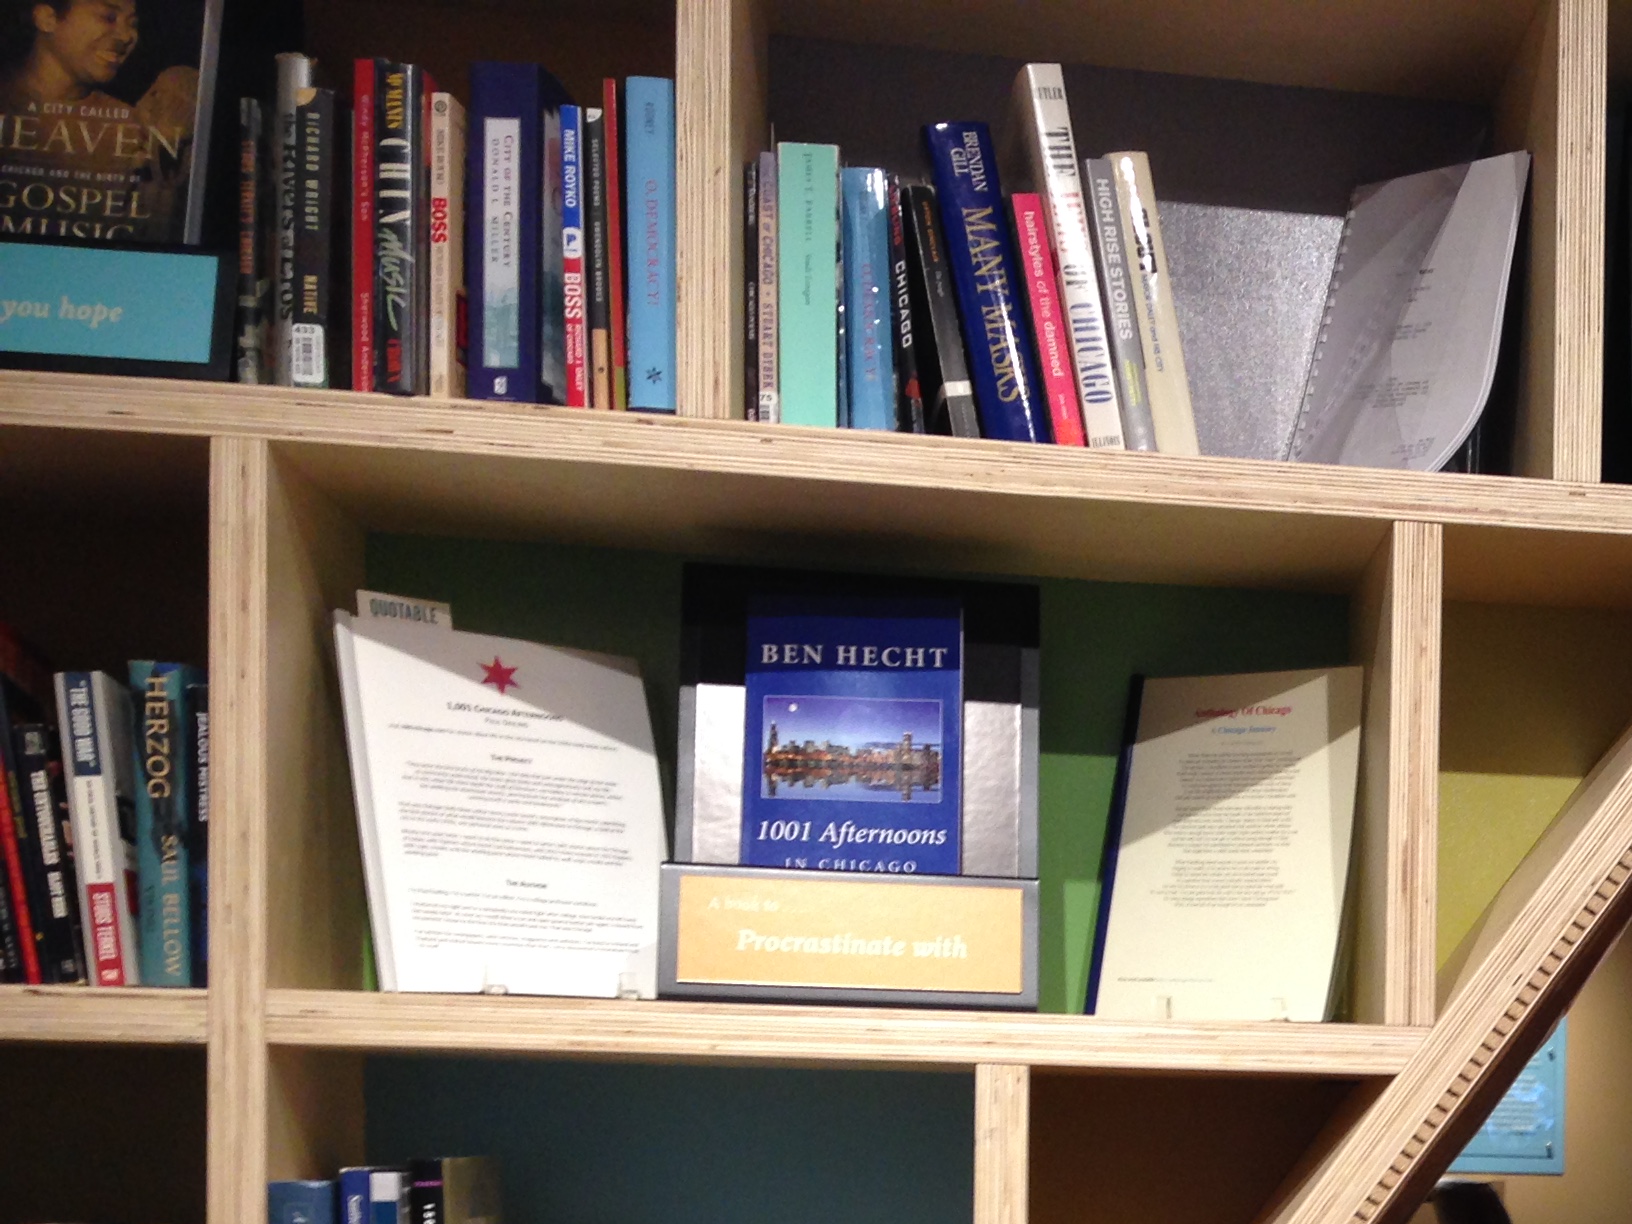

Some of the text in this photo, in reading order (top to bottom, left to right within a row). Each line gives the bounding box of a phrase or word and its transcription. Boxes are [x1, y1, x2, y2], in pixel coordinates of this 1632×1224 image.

[27, 102, 130, 119] A CITY CALLED
[304, 112, 320, 230] RICHARD WRIGHT
[504, 135, 514, 162] CITY
[564, 129, 577, 208] MIKE ROYKO
[591, 138, 601, 206] SELECTED POEMS
[950, 147, 967, 176] GILL
[962, 131, 988, 192] BRENDAN
[1045, 126, 1075, 176] THE
[50, 168, 69, 178] AND
[74, 169, 92, 180] THE
[96, 172, 126, 183] BIRTH
[129, 174, 141, 183] OF
[378, 138, 411, 224] CHIN
[504, 168, 511, 181] OF
[0, 179, 150, 219] GOSPEL
[361, 201, 369, 221] Son
[432, 198, 448, 243] BOSS
[503, 212, 513, 268] CENTURY
[593, 221, 602, 268] GWENDOLYN
[1096, 179, 1133, 339] HIGH RISE STORIES
[303, 275, 318, 314] NATIVE
[378, 228, 415, 331] Music
[564, 273, 581, 319] BOSS
[1024, 211, 1065, 376] hairstyles of the damned
[1063, 263, 1085, 288] OF
[0, 296, 123, 328] you hope
[361, 292, 370, 341] Sherwood
[894, 260, 913, 348] CHICAGO
[961, 206, 1028, 402] MANY MASKS
[763, 302, 774, 388] STUART DYBEK
[1069, 303, 1113, 405] CHICAGO
[369, 598, 439, 624] QUOTABLE
[761, 643, 948, 668] BEN HECHT
[71, 708, 91, 735] GOOD
[144, 676, 171, 799] HERZOG
[757, 819, 948, 848] 1001 Afternoons
[784, 857, 917, 873] IN CHICAGO
[93, 892, 117, 961] STUDS TERKEL
[160, 834, 182, 977] SAUL BELLOW
[736, 929, 968, 959] Procrastinate with
